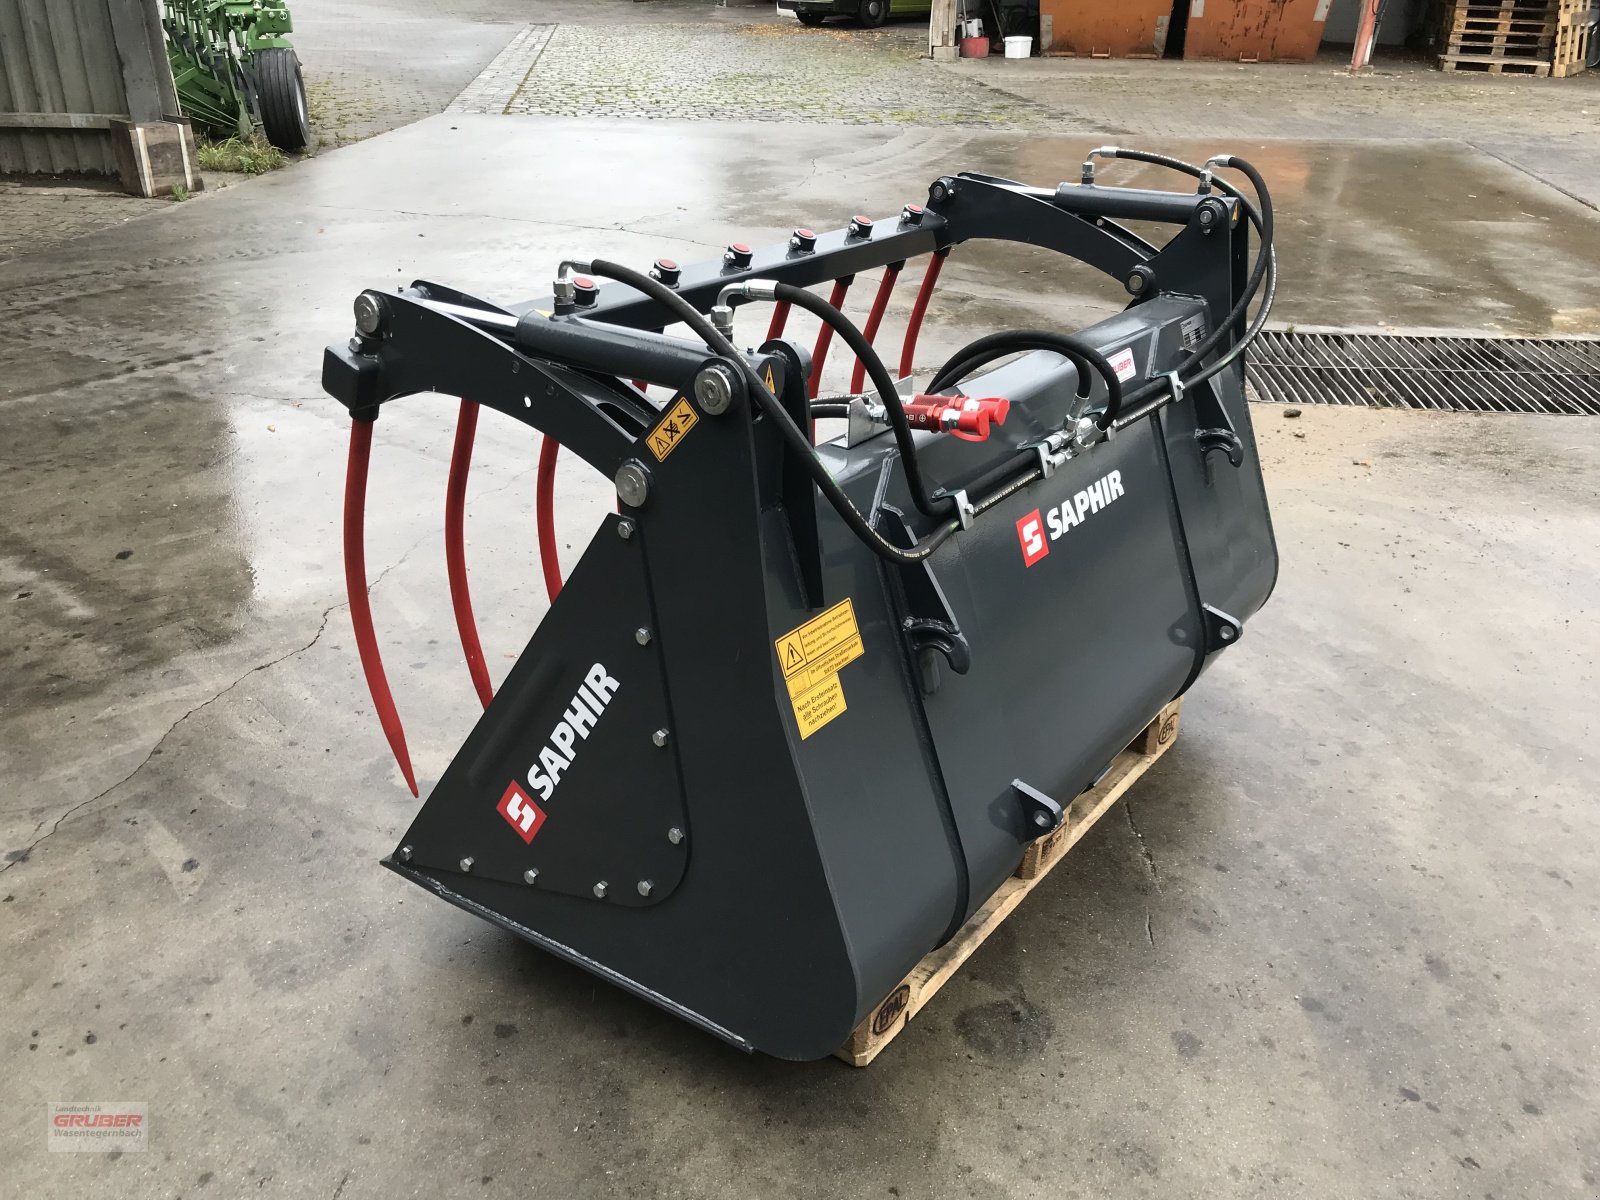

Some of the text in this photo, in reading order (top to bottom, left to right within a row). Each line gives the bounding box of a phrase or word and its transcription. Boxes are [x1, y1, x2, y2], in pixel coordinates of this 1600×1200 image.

[1046, 469, 1125, 541] SAPHIR
[797, 681, 837, 712] Nach Ersteinsatz
[802, 691, 837, 720] alle Schrauben
[807, 702, 837, 726] nachziehen!
[527, 662, 621, 802] SAPHIR
